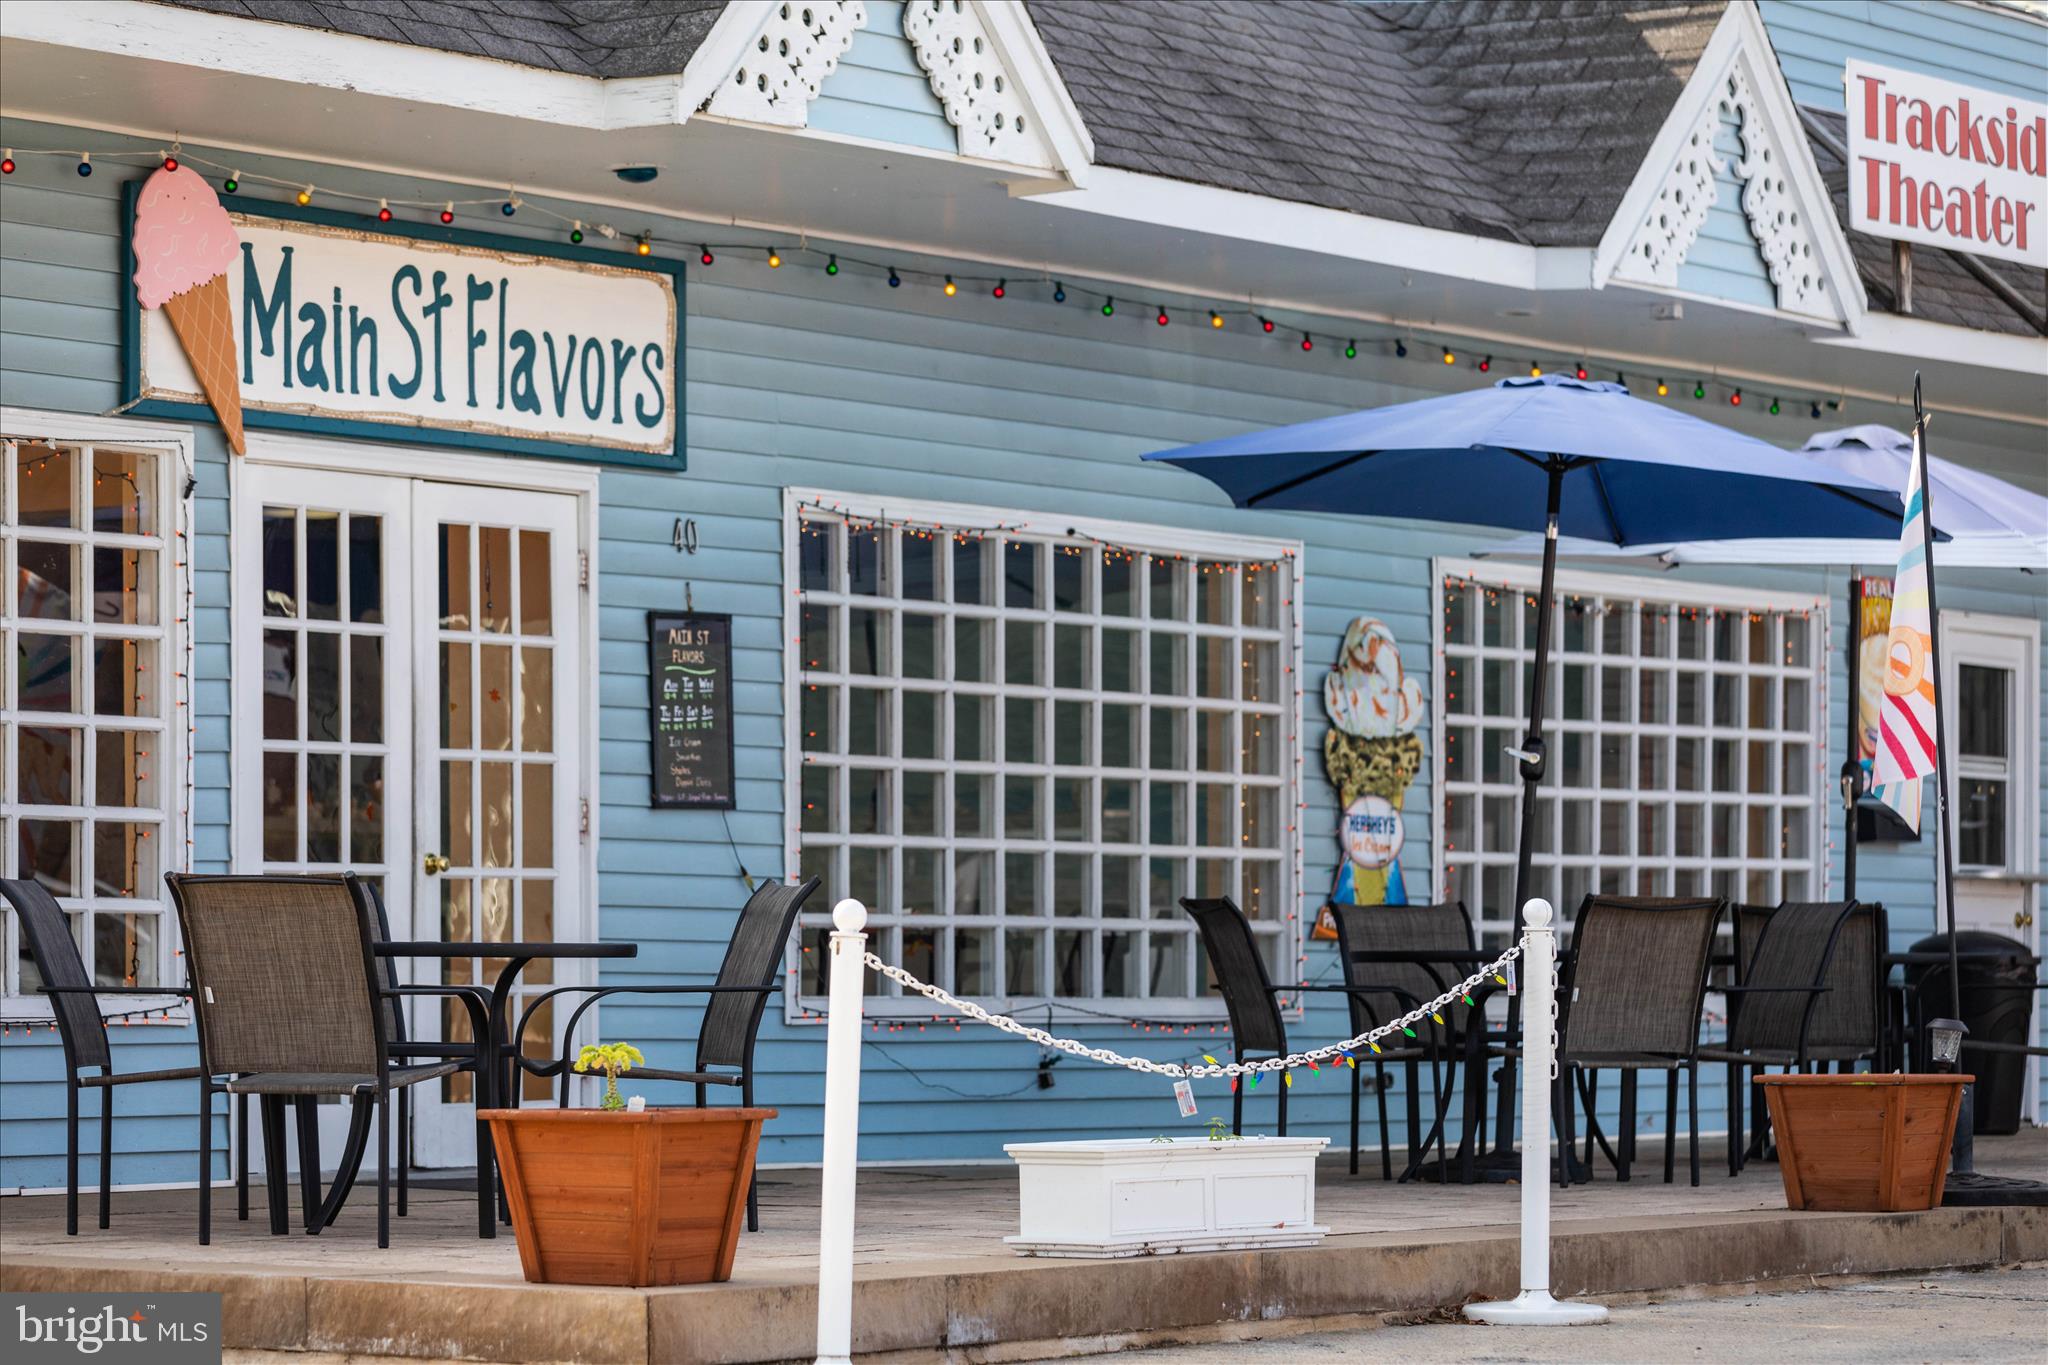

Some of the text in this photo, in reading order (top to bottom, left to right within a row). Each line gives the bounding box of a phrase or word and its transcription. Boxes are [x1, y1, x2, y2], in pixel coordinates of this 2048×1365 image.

[1856, 74, 2047, 178] Tracksid
[1857, 155, 2036, 251] Theater
[240, 241, 665, 429] Main St Flavors
[672, 517, 697, 555] 40
[668, 628, 710, 646] MAIN ST
[672, 648, 705, 664] FLAVORS
